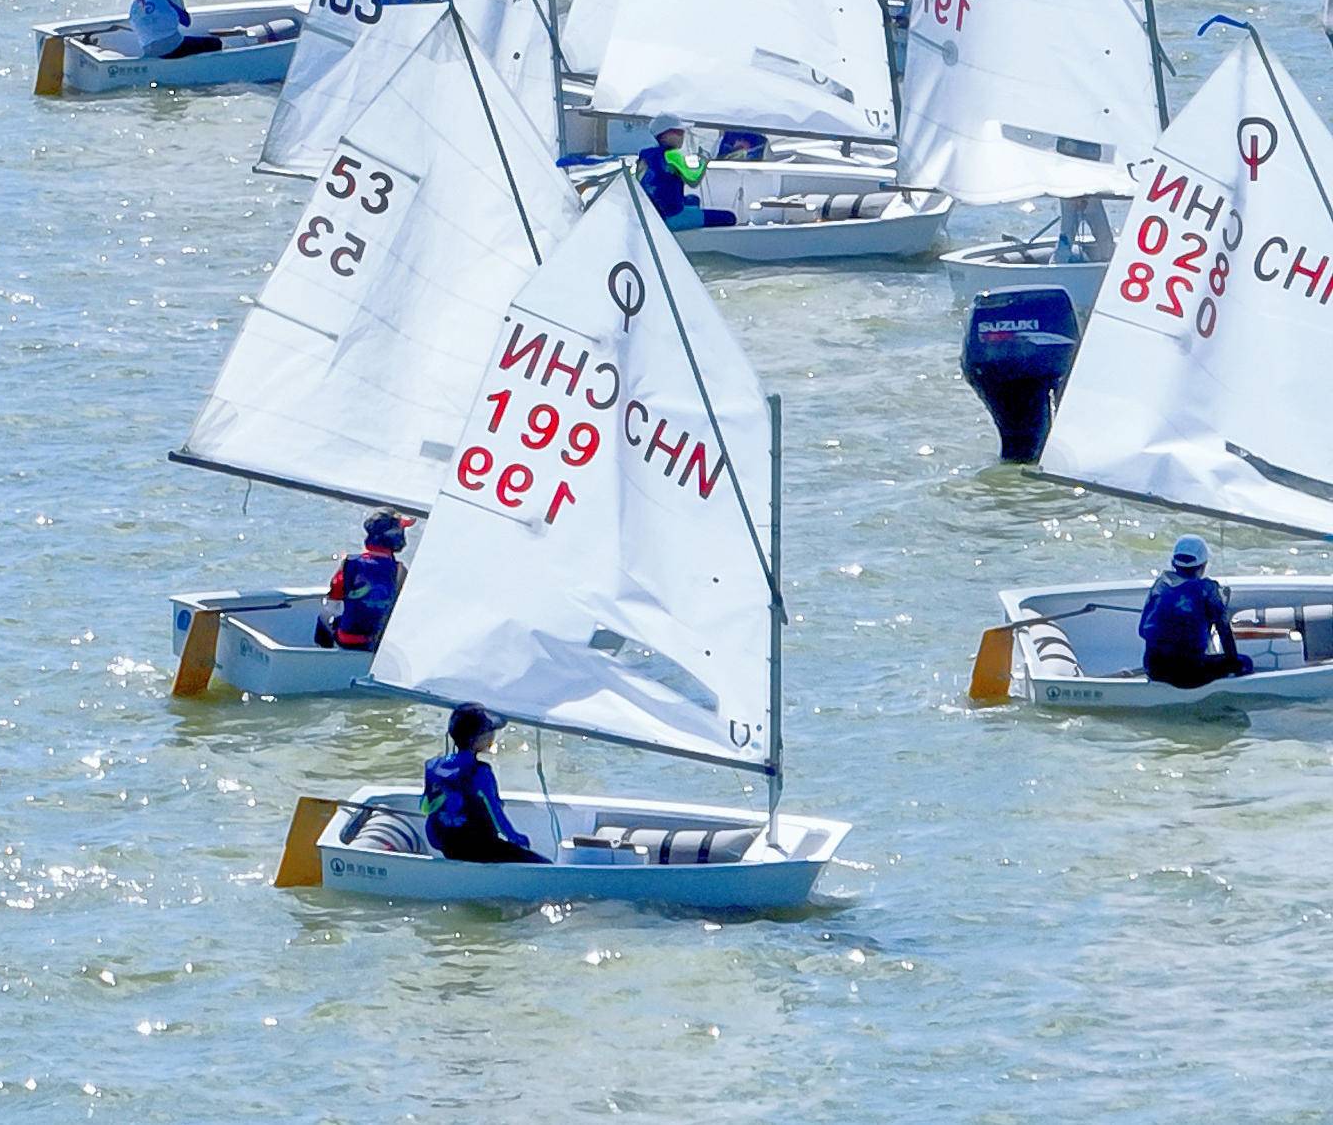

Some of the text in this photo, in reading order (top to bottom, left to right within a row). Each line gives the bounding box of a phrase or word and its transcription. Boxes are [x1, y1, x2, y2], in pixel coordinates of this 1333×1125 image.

[326, 155, 394, 214] 53
[1137, 215, 1230, 297] 028
[978, 319, 1039, 332] SUZUKI
[487, 389, 600, 467] 199
[624, 399, 727, 500] CHN
